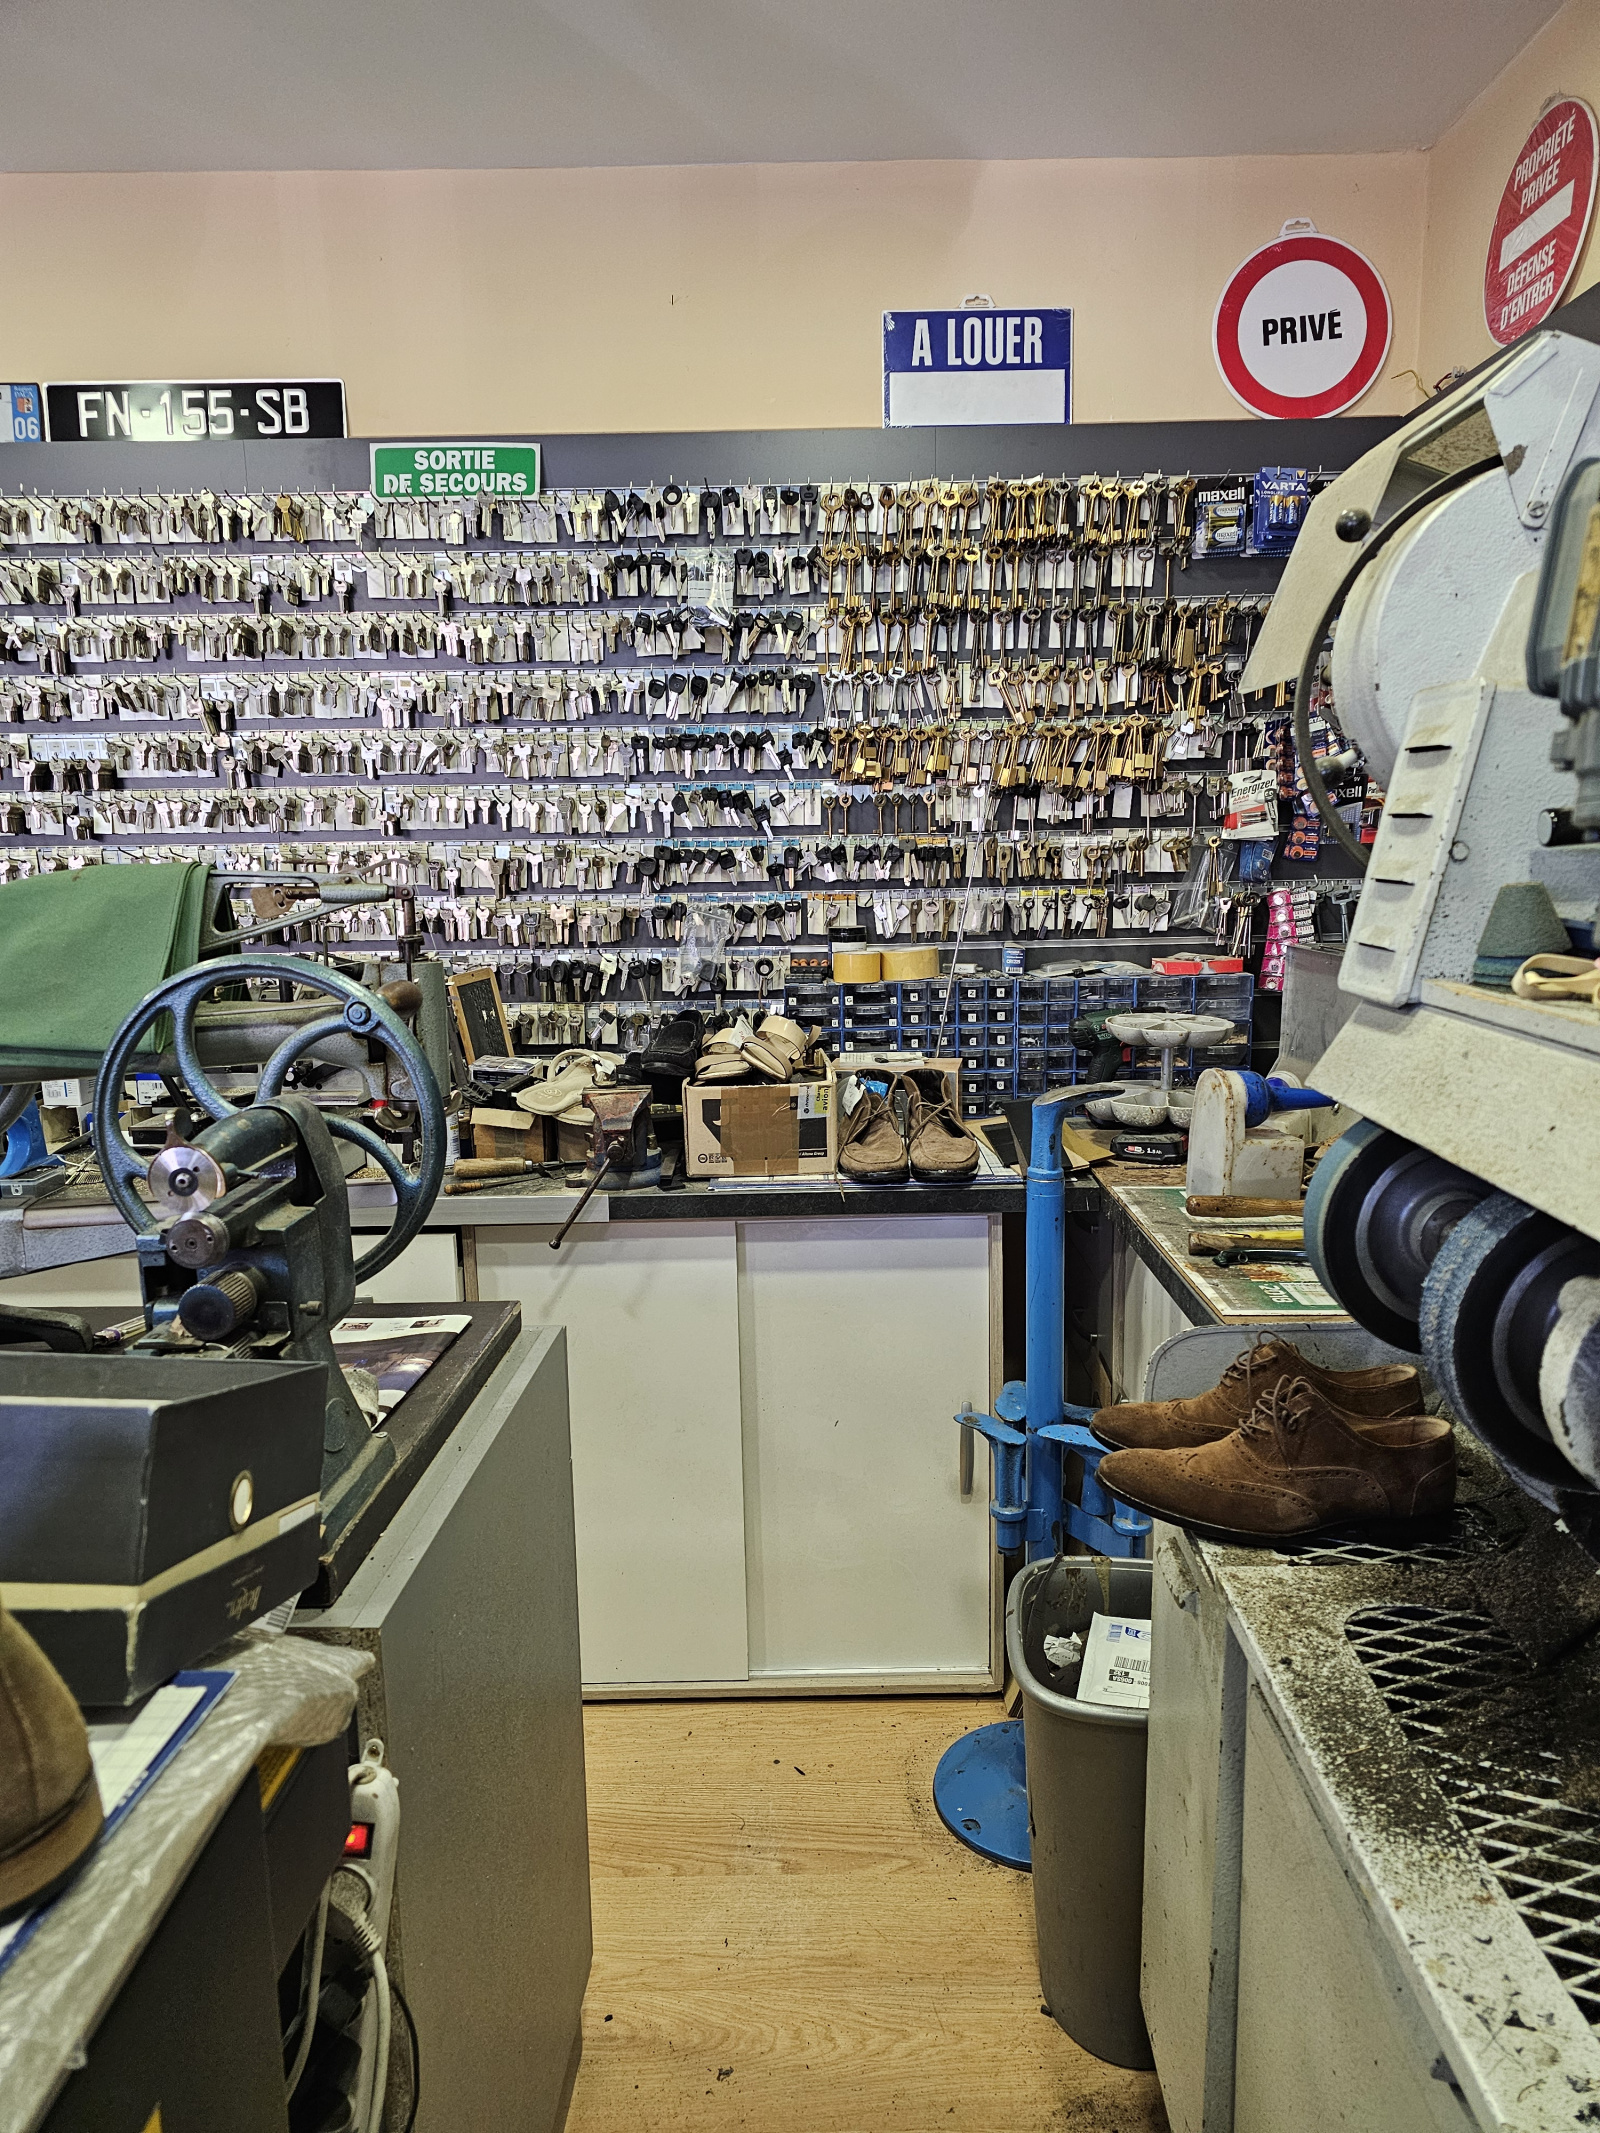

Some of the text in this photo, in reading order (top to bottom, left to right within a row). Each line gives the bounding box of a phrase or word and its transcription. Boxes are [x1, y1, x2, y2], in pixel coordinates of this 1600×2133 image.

[1514, 107, 1576, 191] PROPRIÉTÉ
[1520, 158, 1561, 215] PRIVÉE
[1506, 238, 1557, 298] DÉFENSE
[1500, 270, 1555, 332] D'ENTRER
[1262, 308, 1343, 346] PRIVÉ
[911, 316, 1043, 366] A LOUER
[14, 416, 39, 440] 06
[414, 450, 495, 471] SORTIE
[383, 472, 528, 494] DE SECOURS
[1199, 487, 1244, 502] maxell
[1262, 481, 1305, 491] VARTA
[1231, 778, 1275, 798] Energizer
[1335, 785, 1362, 798] xell
